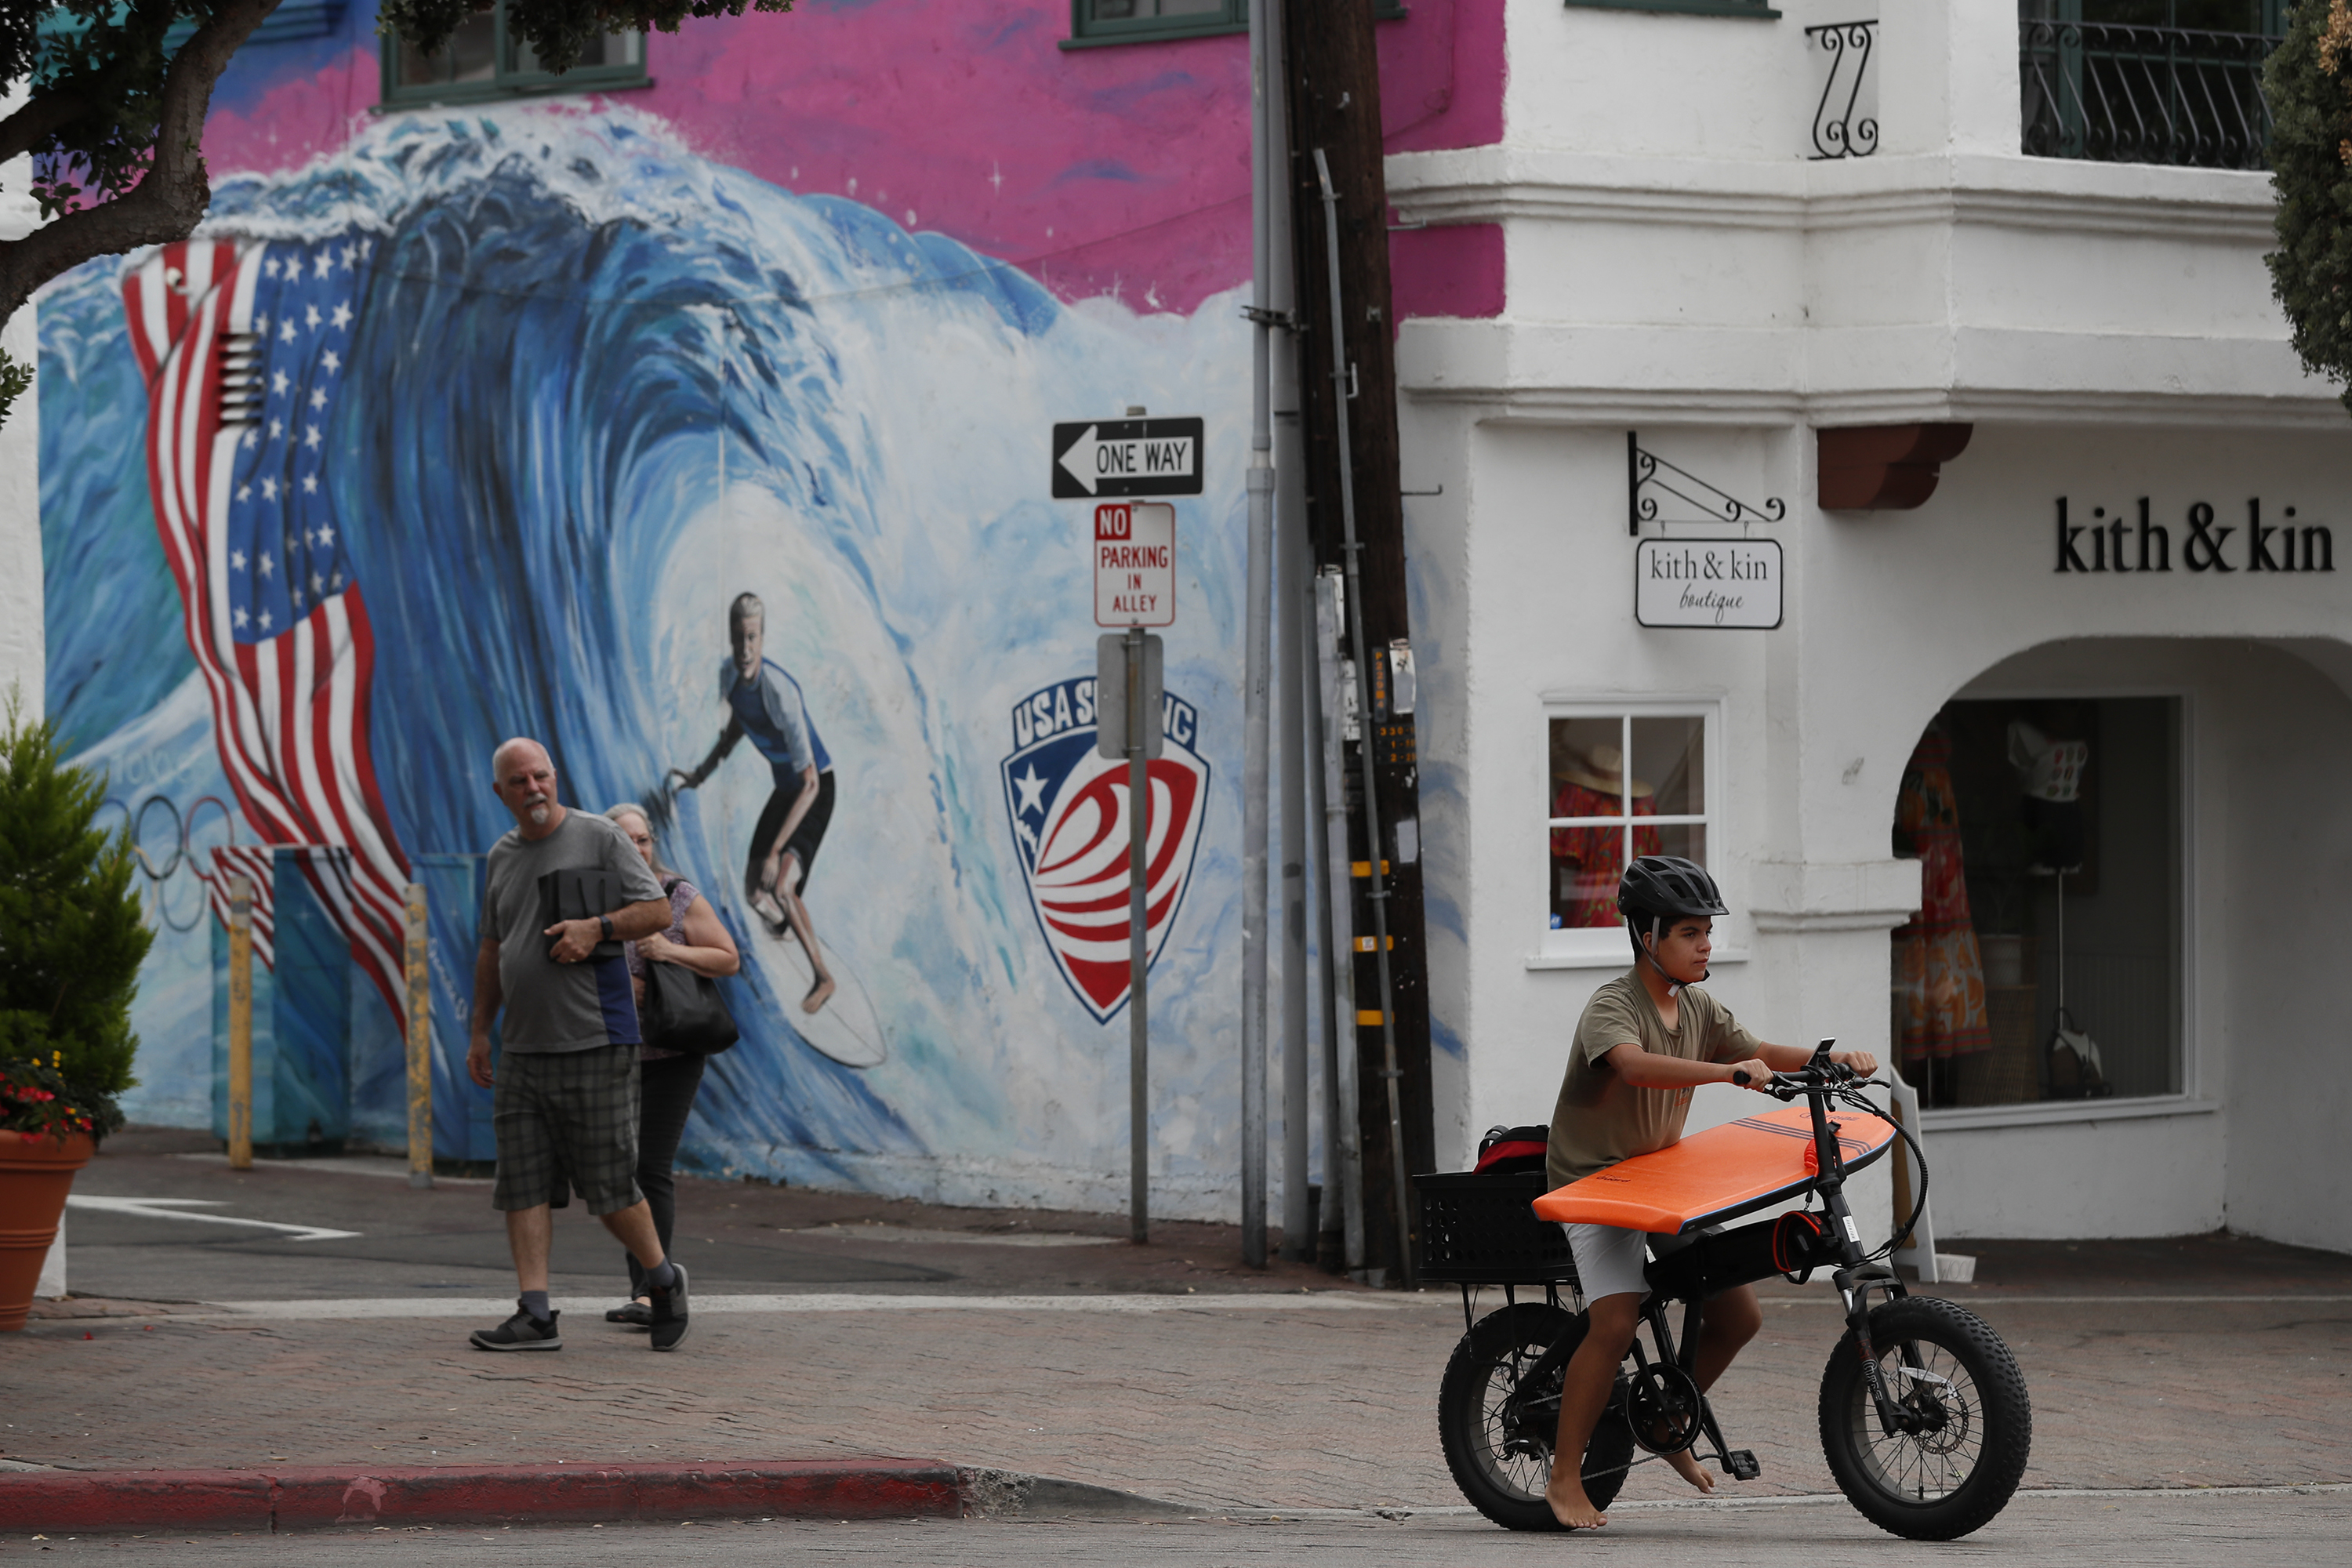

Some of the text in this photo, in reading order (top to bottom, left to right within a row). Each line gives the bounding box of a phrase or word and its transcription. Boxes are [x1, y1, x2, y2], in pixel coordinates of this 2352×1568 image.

[1097, 441, 1186, 474] ONE WAY
[1099, 508, 1127, 536] NO
[2053, 495, 2174, 573] kith
[2246, 496, 2336, 573] kin
[1101, 546, 1168, 568] PARKING
[1650, 549, 1767, 580] kith & kin
[1128, 573, 1142, 590] IN
[1112, 595, 1157, 612] ALLEY
[1679, 583, 1744, 625] boutique
[1014, 684, 1074, 748] USA
